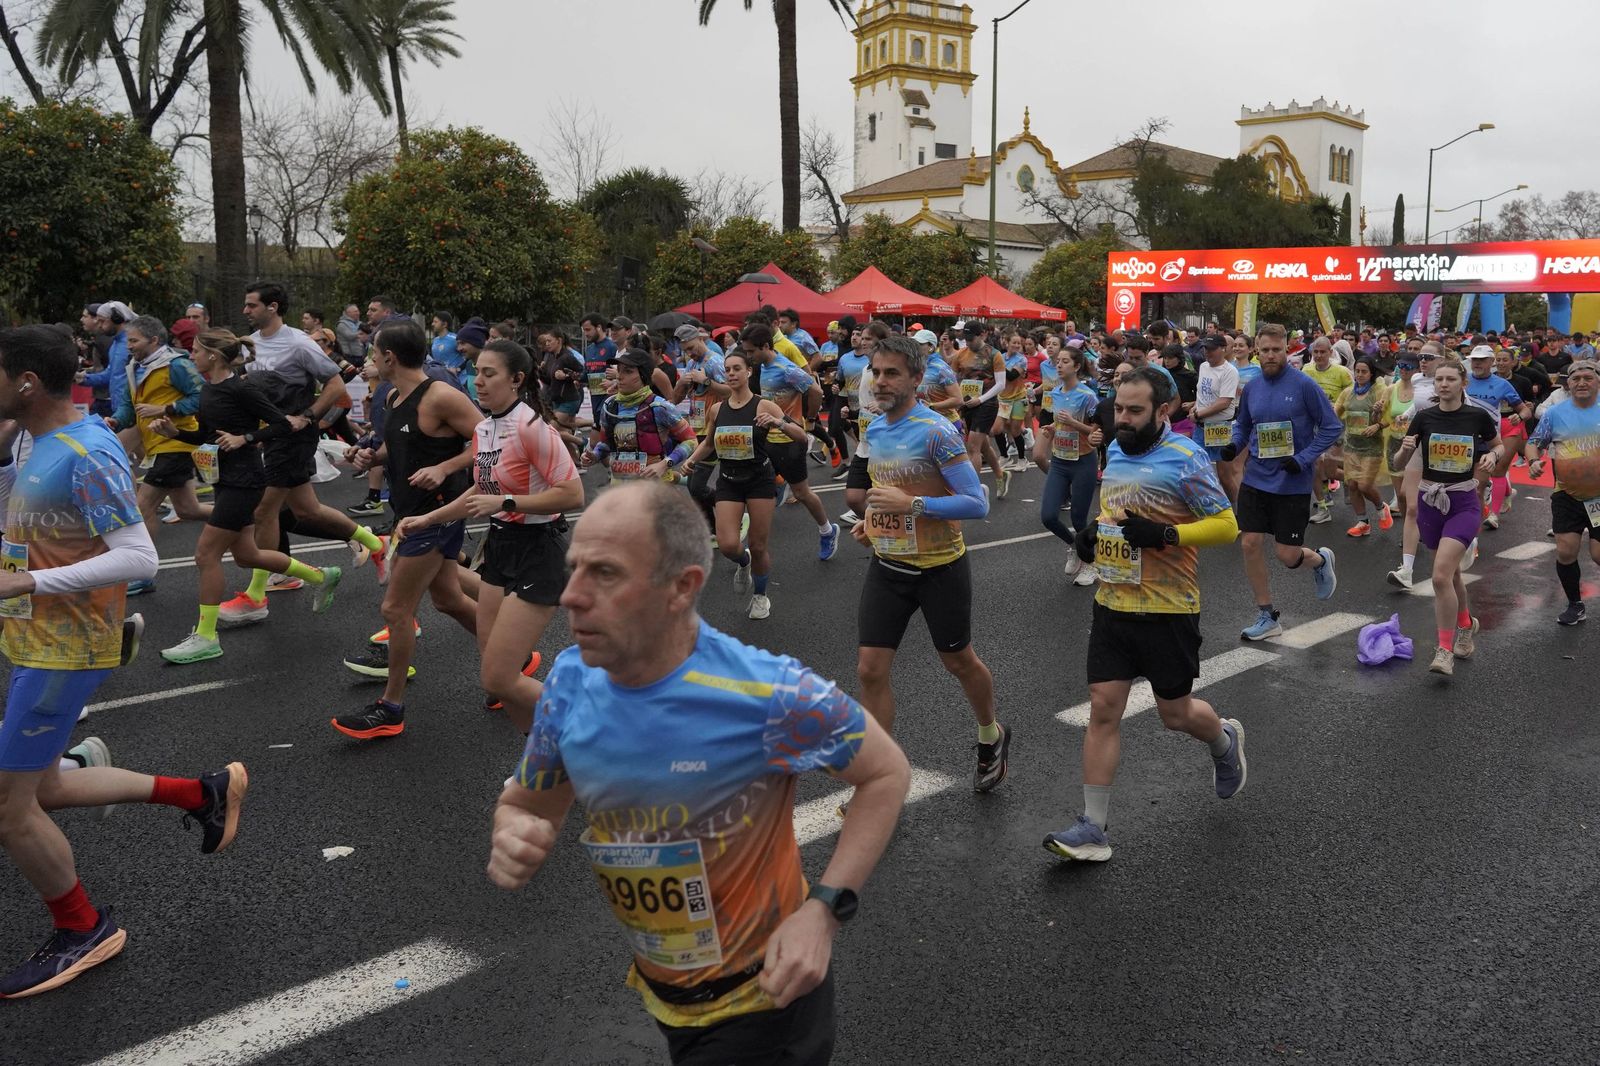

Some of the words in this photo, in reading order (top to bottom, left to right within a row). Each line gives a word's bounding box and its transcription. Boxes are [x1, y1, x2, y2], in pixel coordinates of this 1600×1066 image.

[1377, 253, 1450, 269] maratón
[1542, 257, 1600, 274] HOKA
[1188, 266, 1225, 276] Sprinter
[1265, 263, 1309, 278] HOKA
[1393, 264, 1450, 281] sevilla
[717, 434, 746, 446] 14651
[1432, 443, 1468, 457] 15197
[612, 461, 641, 474] 22486
[871, 513, 901, 530] 6425
[670, 760, 708, 773] HOKA
